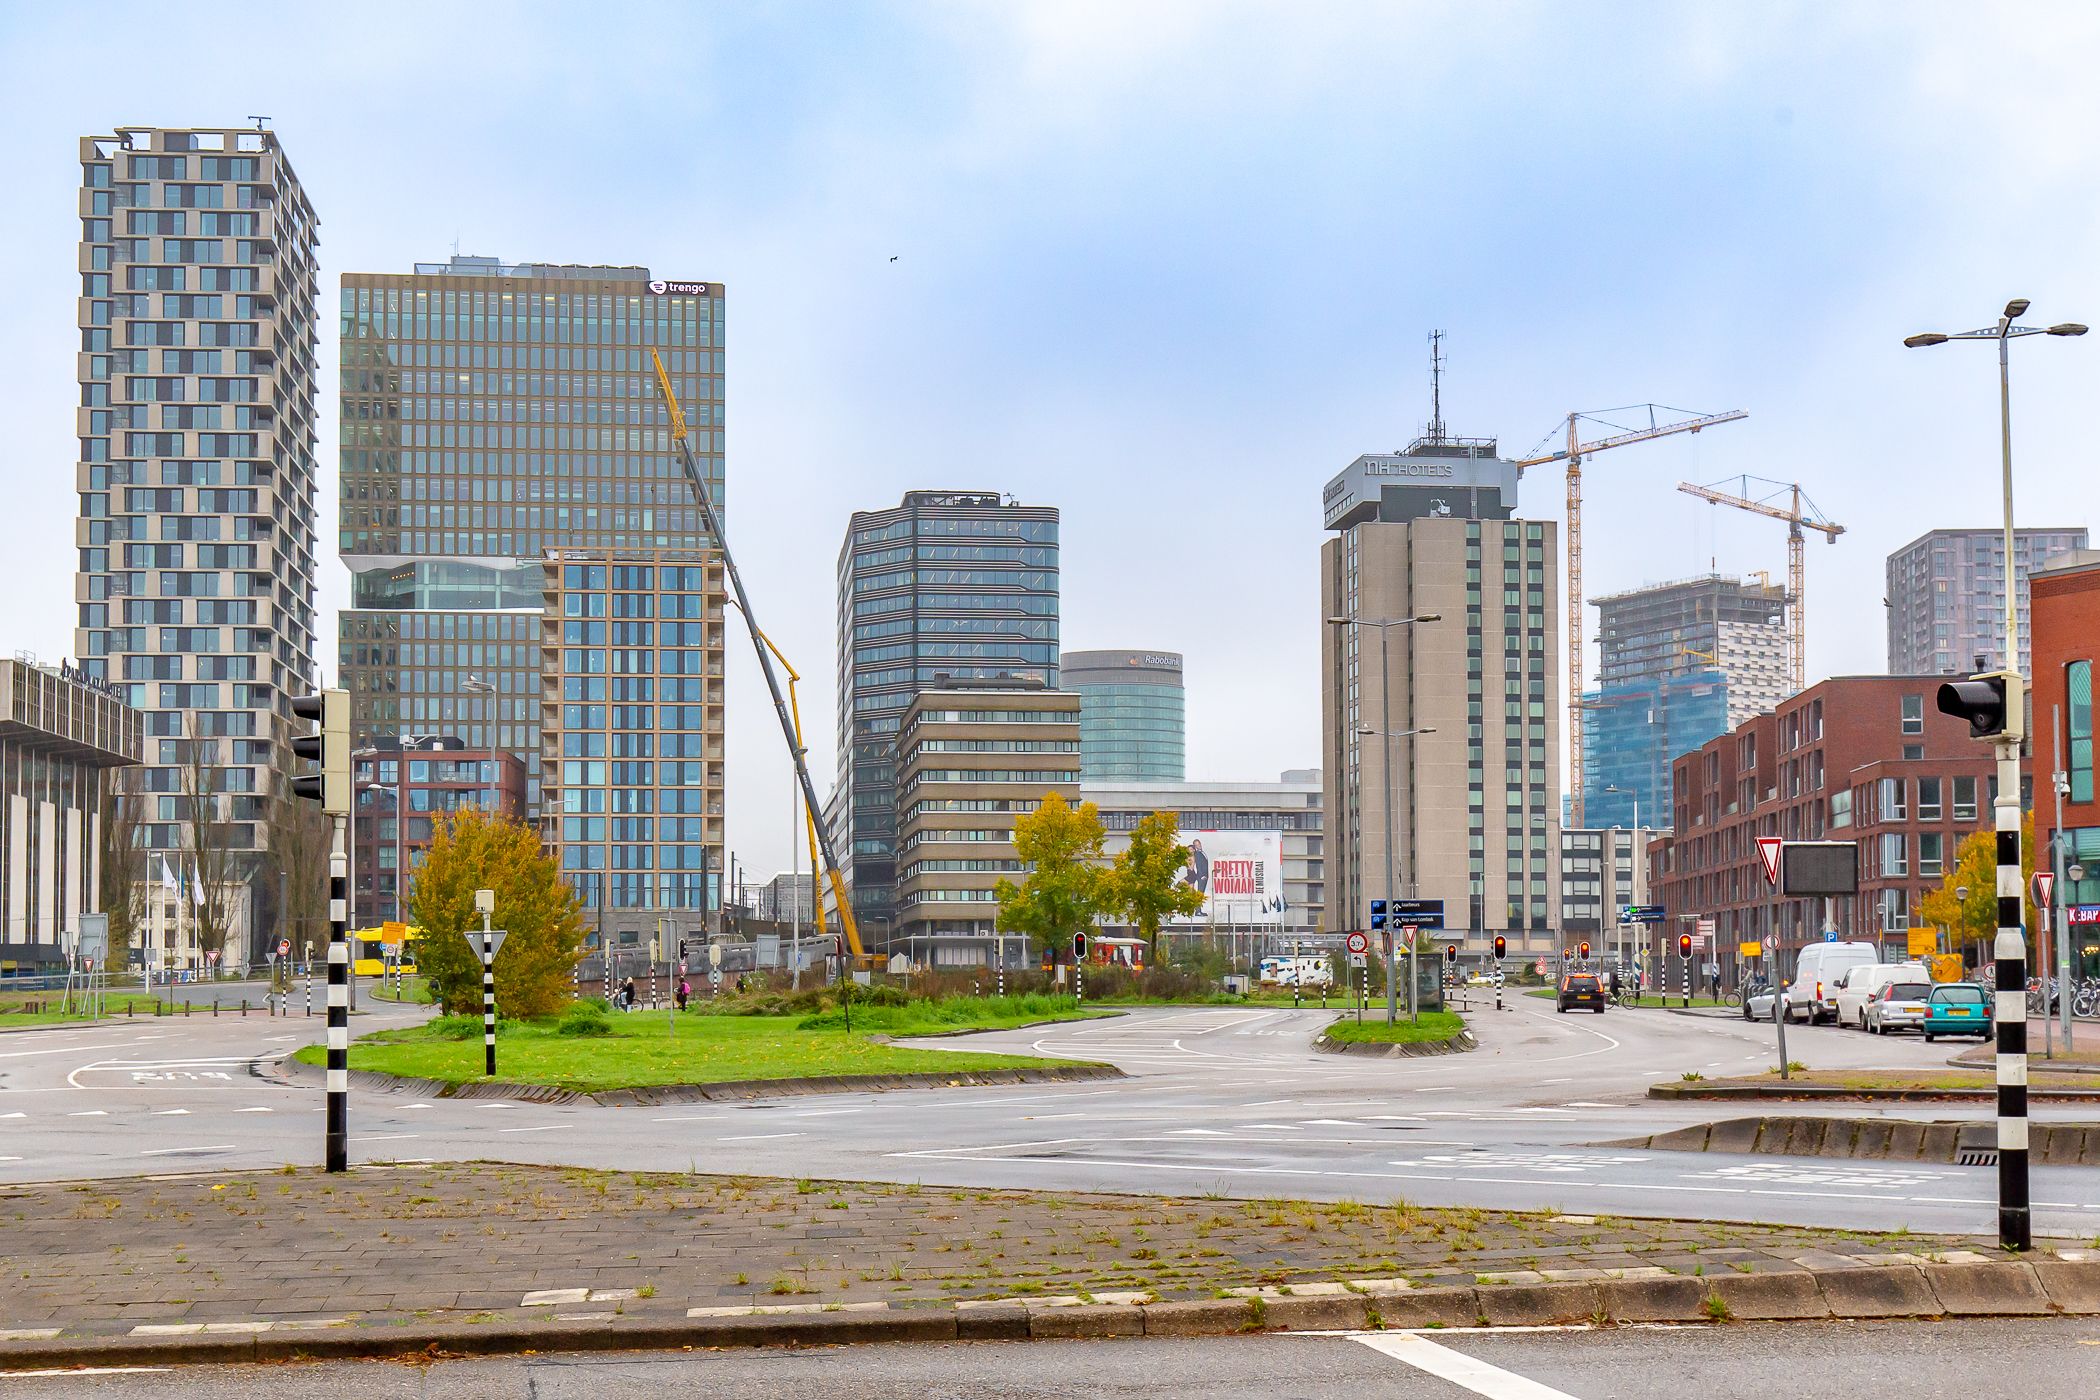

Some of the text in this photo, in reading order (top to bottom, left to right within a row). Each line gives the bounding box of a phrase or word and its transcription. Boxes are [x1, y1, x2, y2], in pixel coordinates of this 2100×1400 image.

[669, 282, 706, 295] trengo
[1398, 464, 1453, 477] HOTELS
[1144, 654, 1180, 667] Rabobank
[1213, 860, 1254, 878] PRETTY
[1255, 861, 1264, 886] MUSICAL
[1213, 878, 1255, 894] WOMAN
